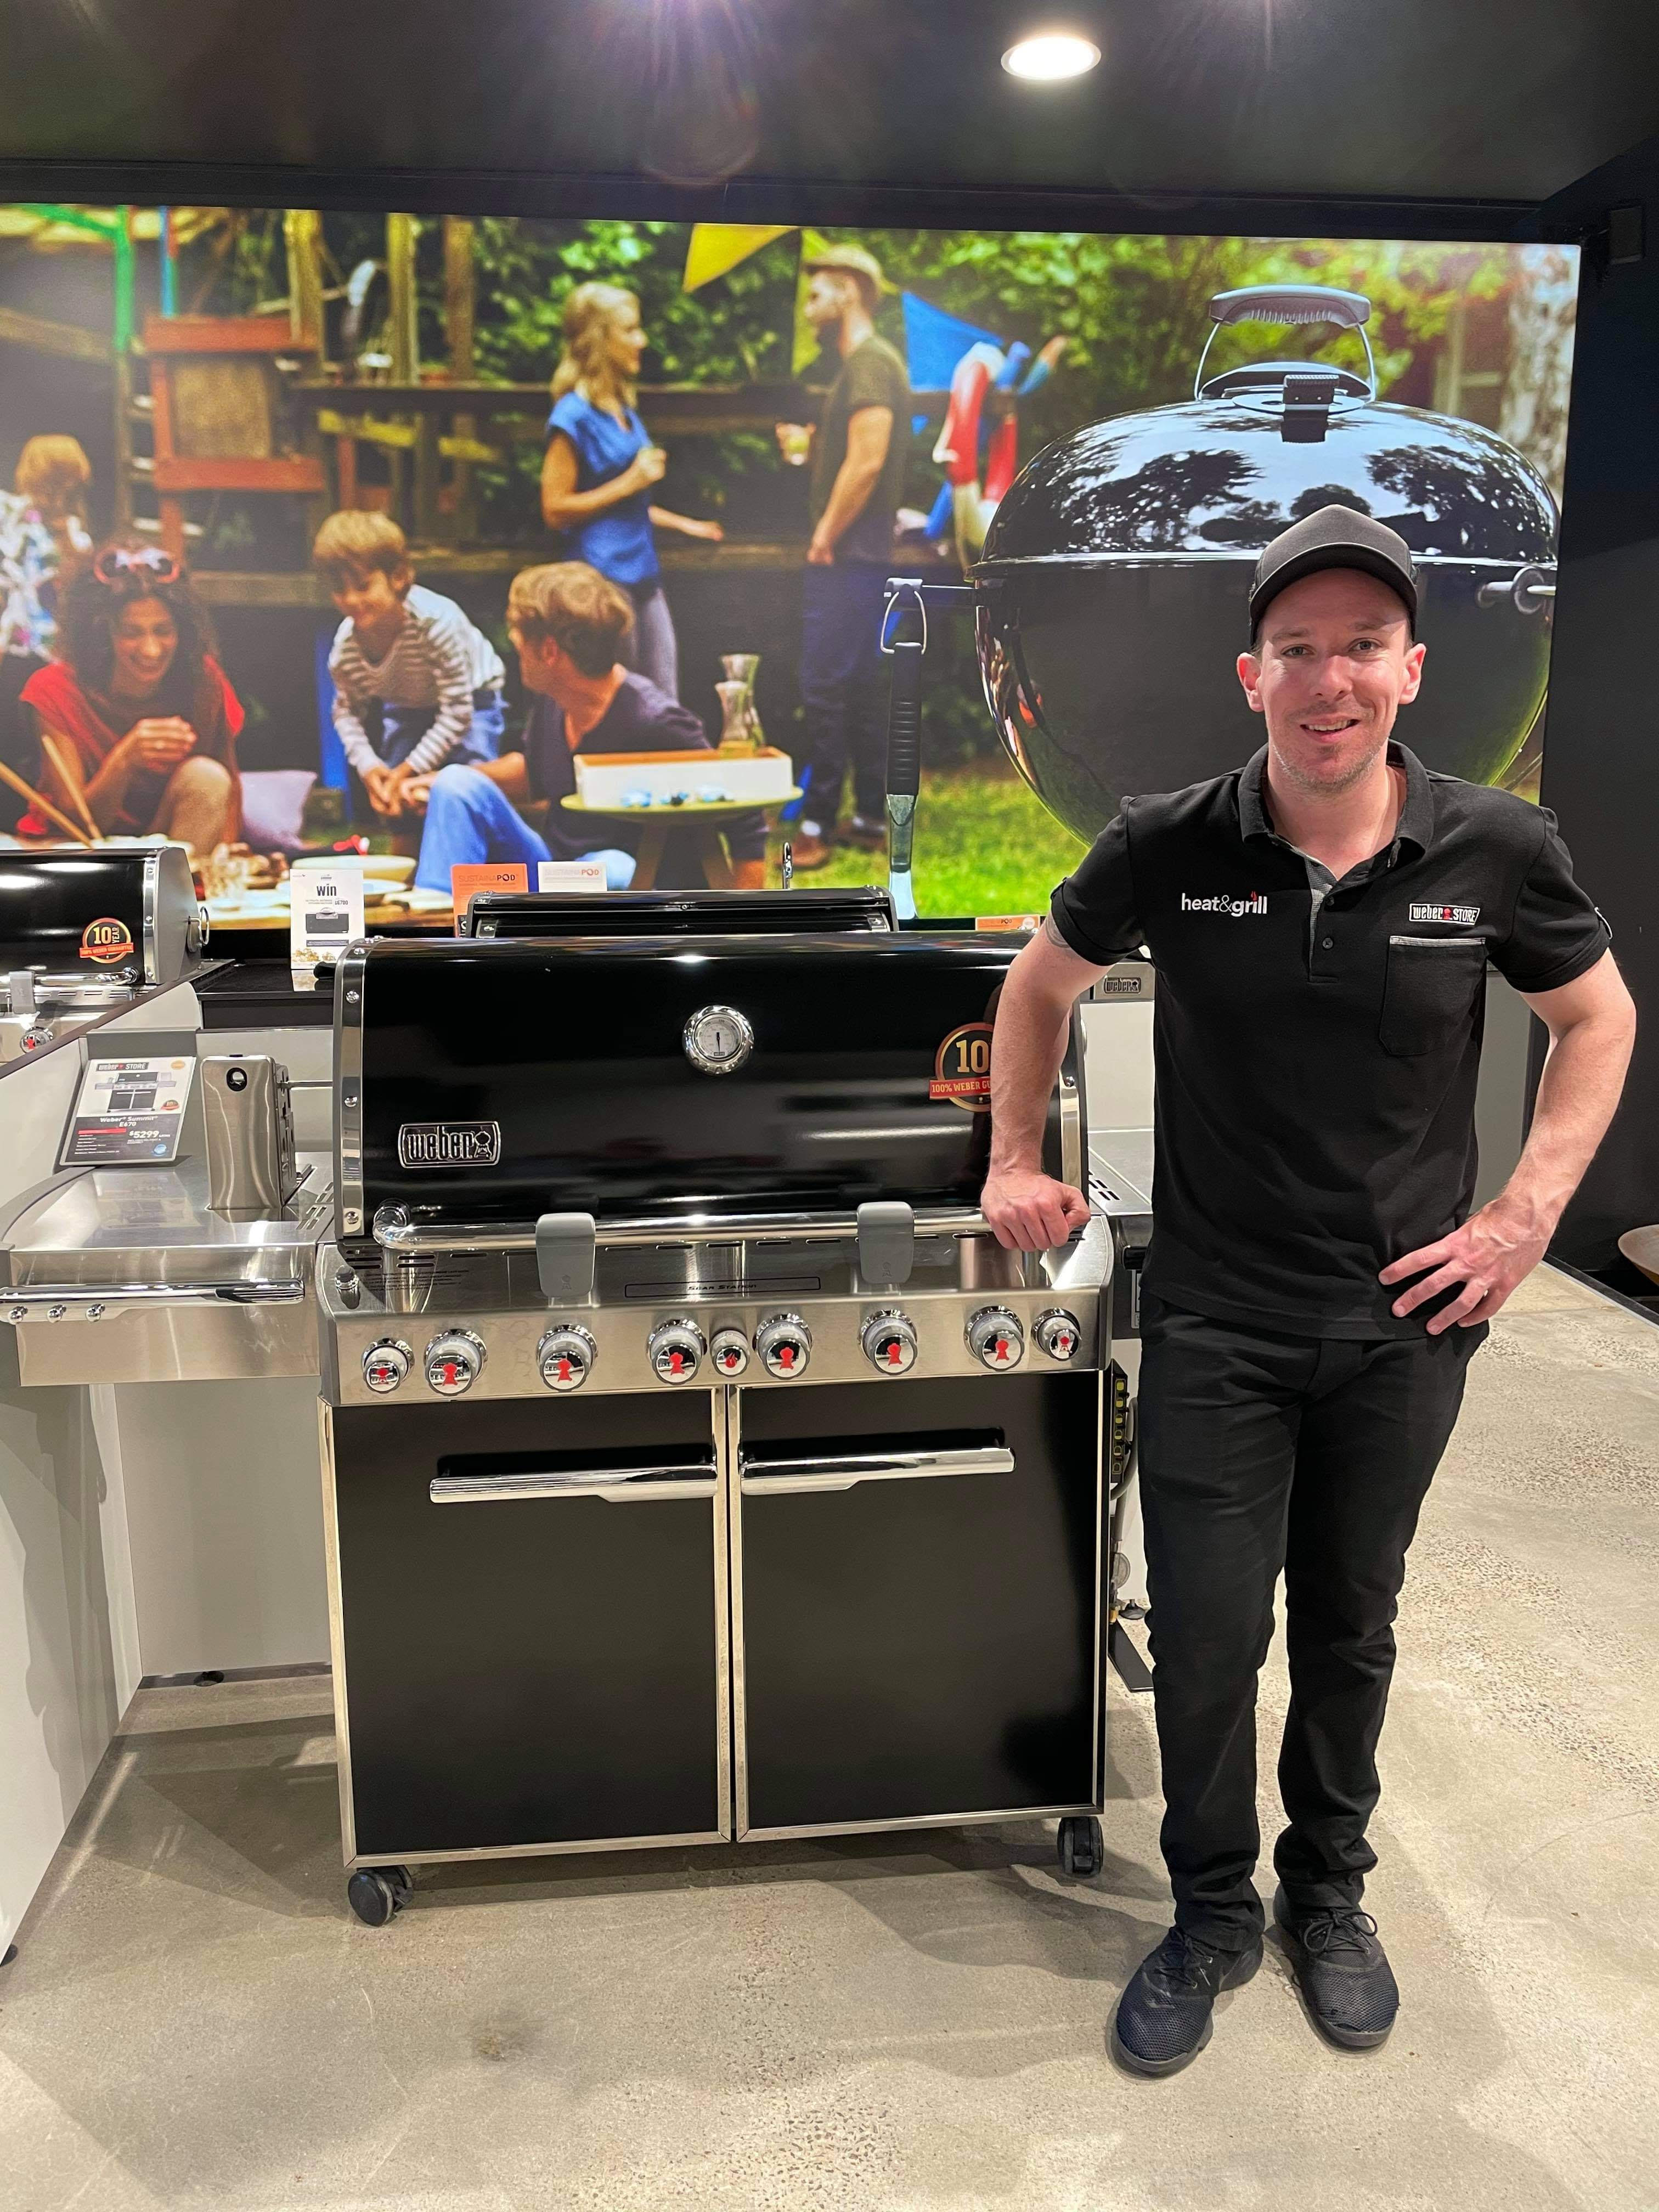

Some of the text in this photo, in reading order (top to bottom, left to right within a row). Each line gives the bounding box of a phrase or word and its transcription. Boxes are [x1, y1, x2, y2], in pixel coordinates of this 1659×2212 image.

[317, 883, 337, 896] win
[1181, 891, 1267, 917] heat&grill
[1413, 904, 1477, 922] weber STORE
[93, 926, 112, 944] 10
[1107, 978, 1132, 992] weber
[956, 1040, 989, 1073] 10
[932, 1084, 952, 1093] 100%
[953, 1081, 980, 1092] WEBER
[129, 1130, 160, 1138] $5299
[407, 1126, 475, 1160] weber
